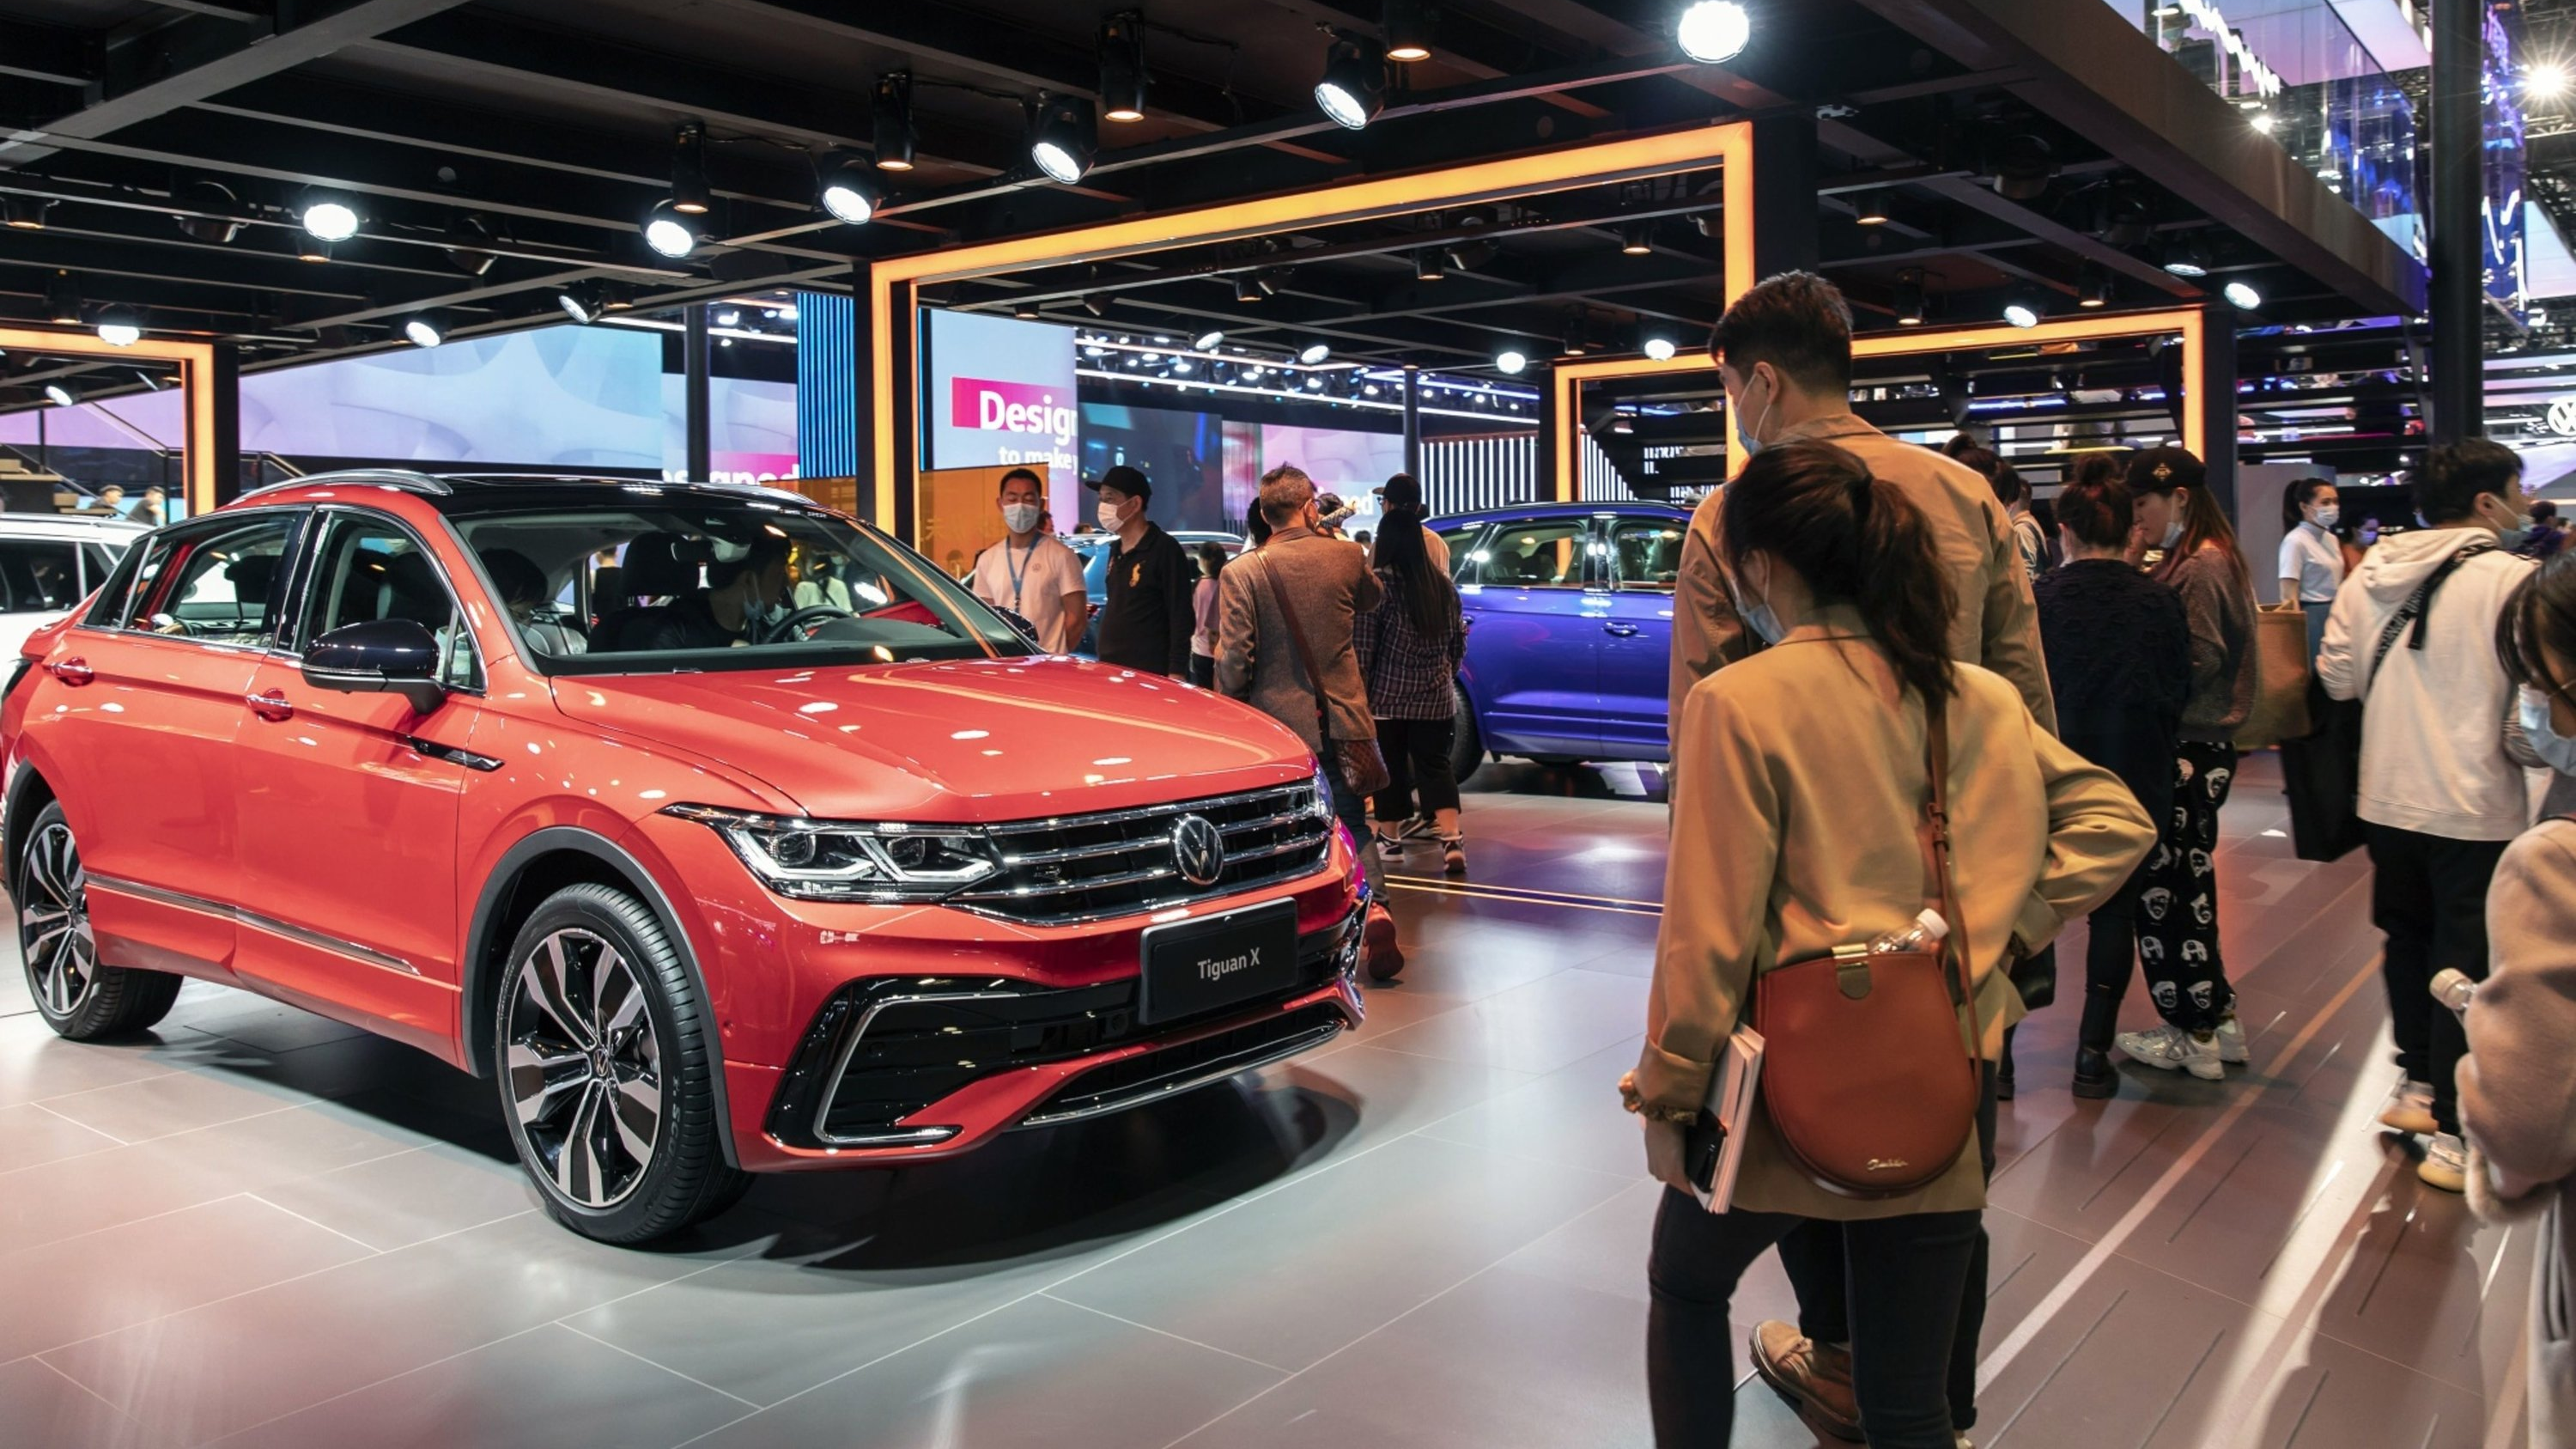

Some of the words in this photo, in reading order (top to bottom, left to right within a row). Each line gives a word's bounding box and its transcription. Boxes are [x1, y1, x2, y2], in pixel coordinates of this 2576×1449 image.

[999, 446, 1020, 465] to
[1024, 447, 1072, 470] make
[1197, 954, 1247, 981] Tiguan
[1250, 947, 1260, 966] X
